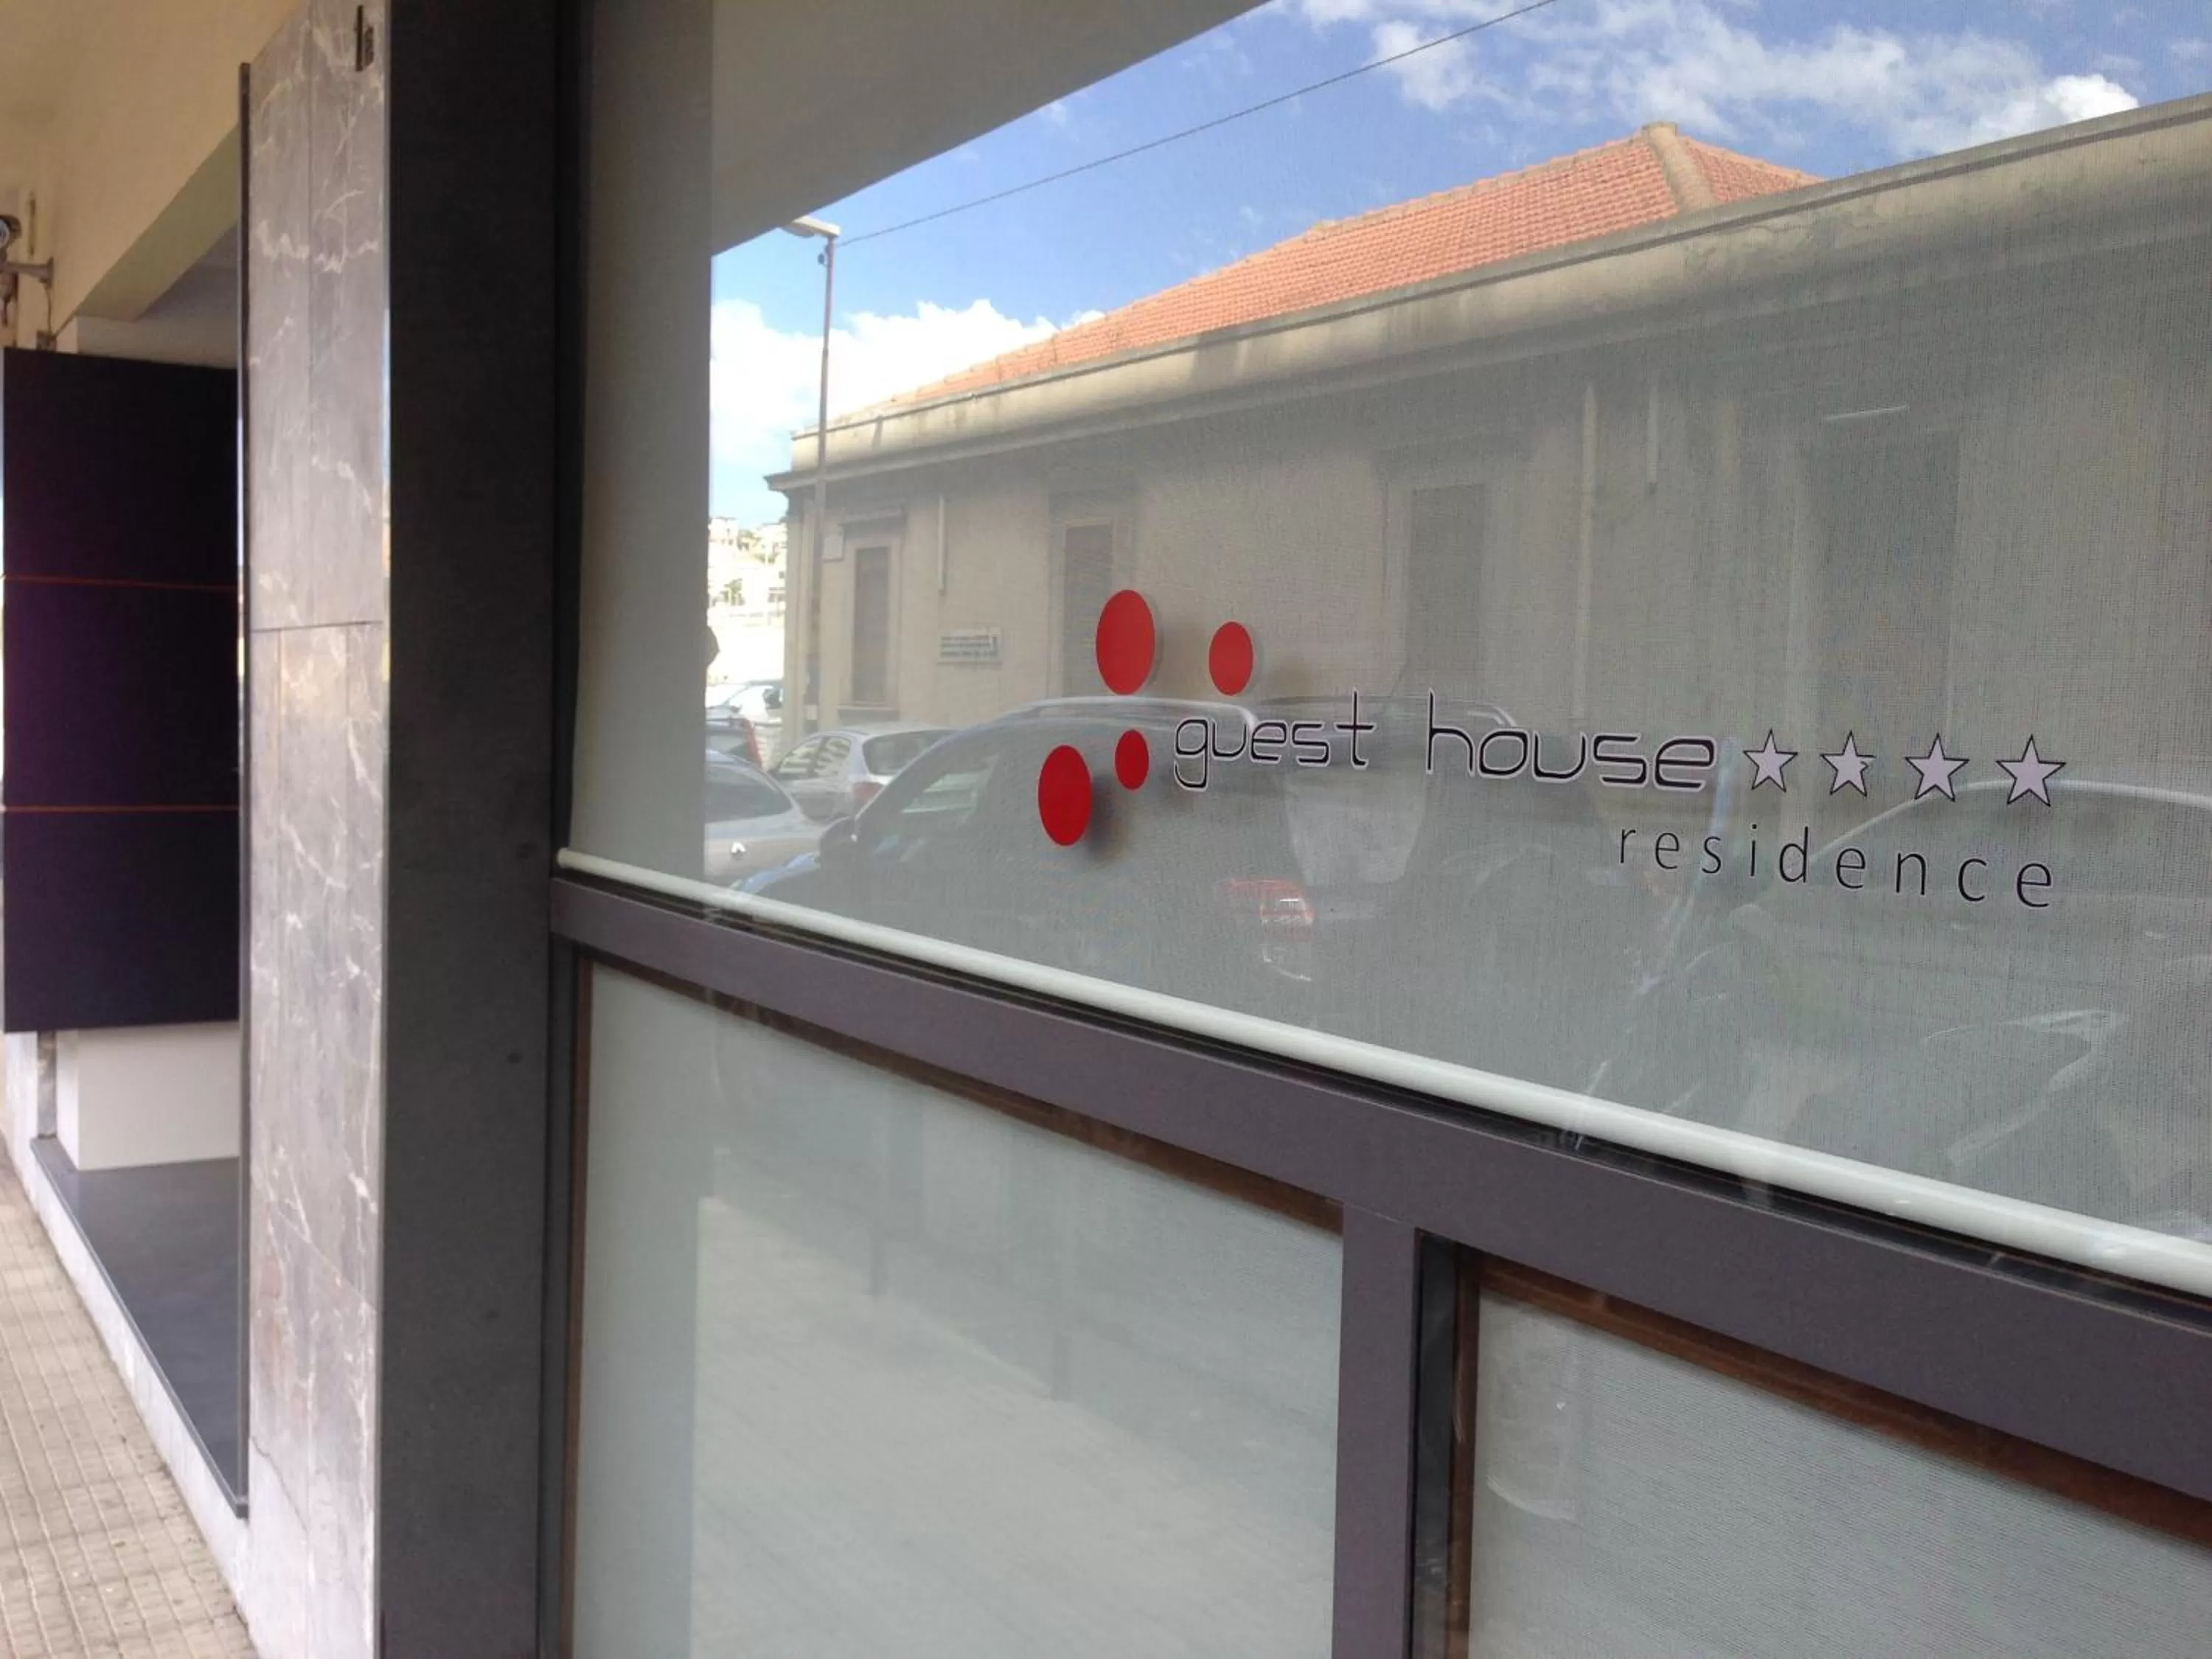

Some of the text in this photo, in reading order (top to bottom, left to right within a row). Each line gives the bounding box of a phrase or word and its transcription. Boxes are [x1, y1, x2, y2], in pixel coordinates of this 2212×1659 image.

[1174, 688, 1717, 792] guest house
[1620, 824, 2052, 908] residence
